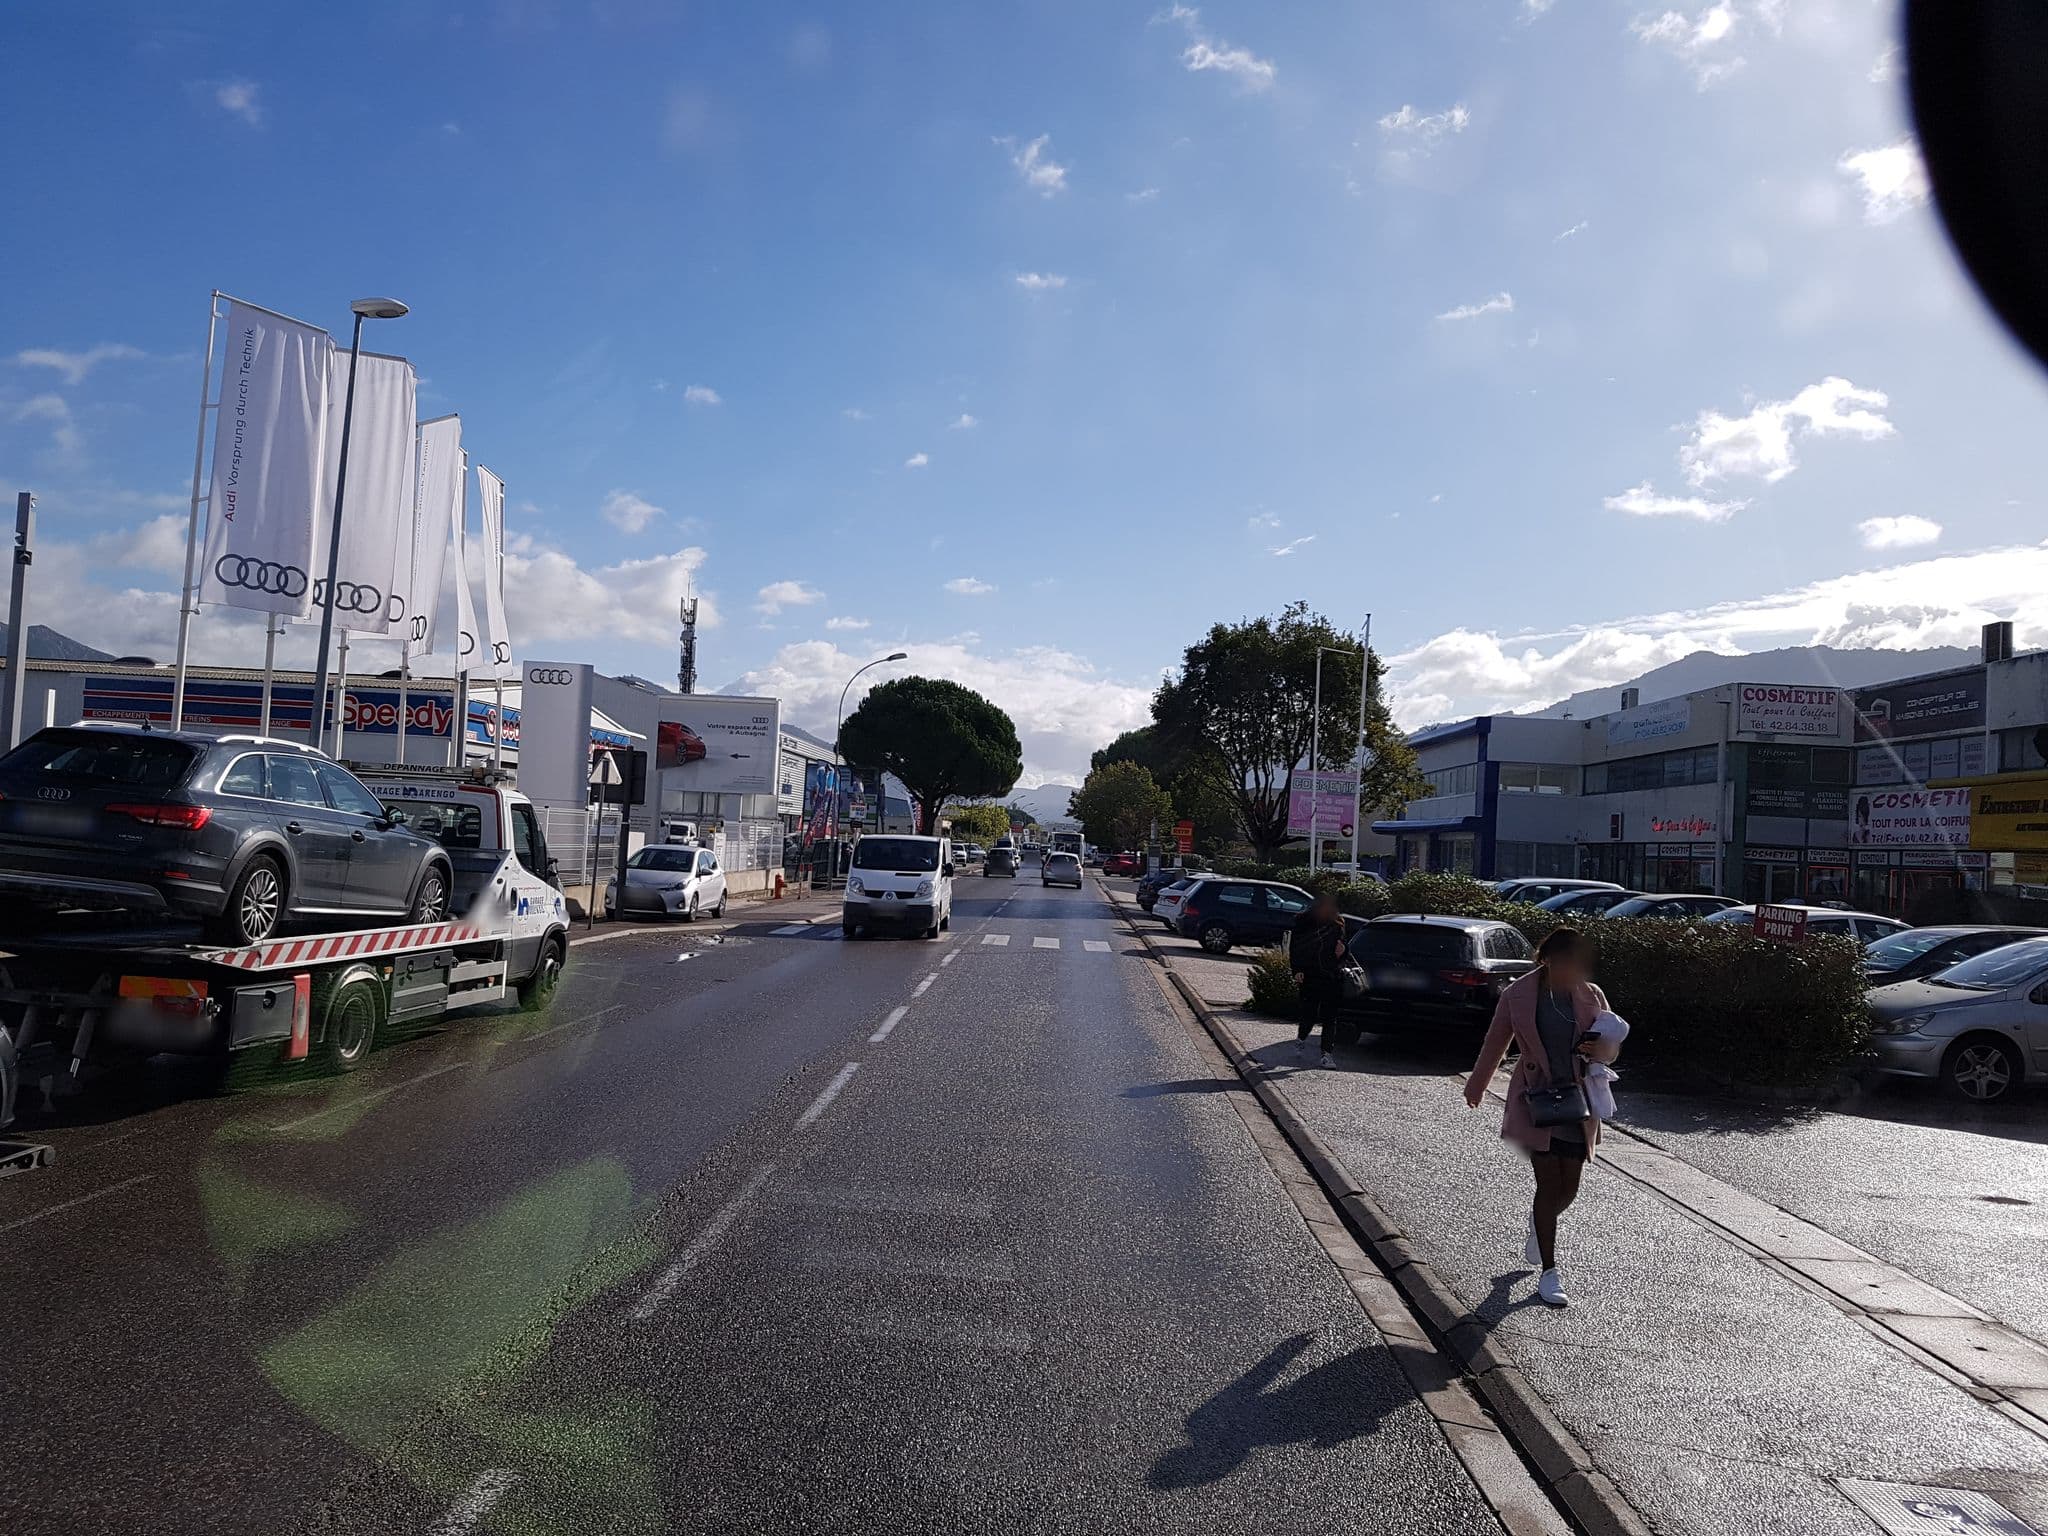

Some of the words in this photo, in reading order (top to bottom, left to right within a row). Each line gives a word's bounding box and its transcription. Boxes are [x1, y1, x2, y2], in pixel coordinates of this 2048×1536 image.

[239, 328, 255, 376] Technik
[235, 379, 249, 416] durch
[227, 419, 247, 487] Vorsprung
[225, 490, 238, 522] Audi
[1743, 687, 1836, 705] COSMETIF
[92, 710, 150, 719] ECHAPPEMENTS
[342, 694, 454, 736] Speedy
[1742, 703, 1763, 714] Tout
[1763, 706, 1783, 717] pour
[1786, 706, 1795, 717] la
[1800, 705, 1836, 721] Coiffure
[707, 722, 726, 730] Votre
[727, 724, 751, 732] espace
[383, 763, 446, 774] DEPANNAGE
[369, 786, 400, 796] ARAGE
[1292, 777, 1357, 794] COSMETIF
[1871, 818, 1891, 828] TOUT
[1894, 818, 1917, 828] POUR
[1920, 818, 1931, 827] LA
[1744, 849, 1795, 859] COSMETIF
[1758, 905, 1803, 923] PARKING
[1764, 921, 1794, 937] PRIVE
